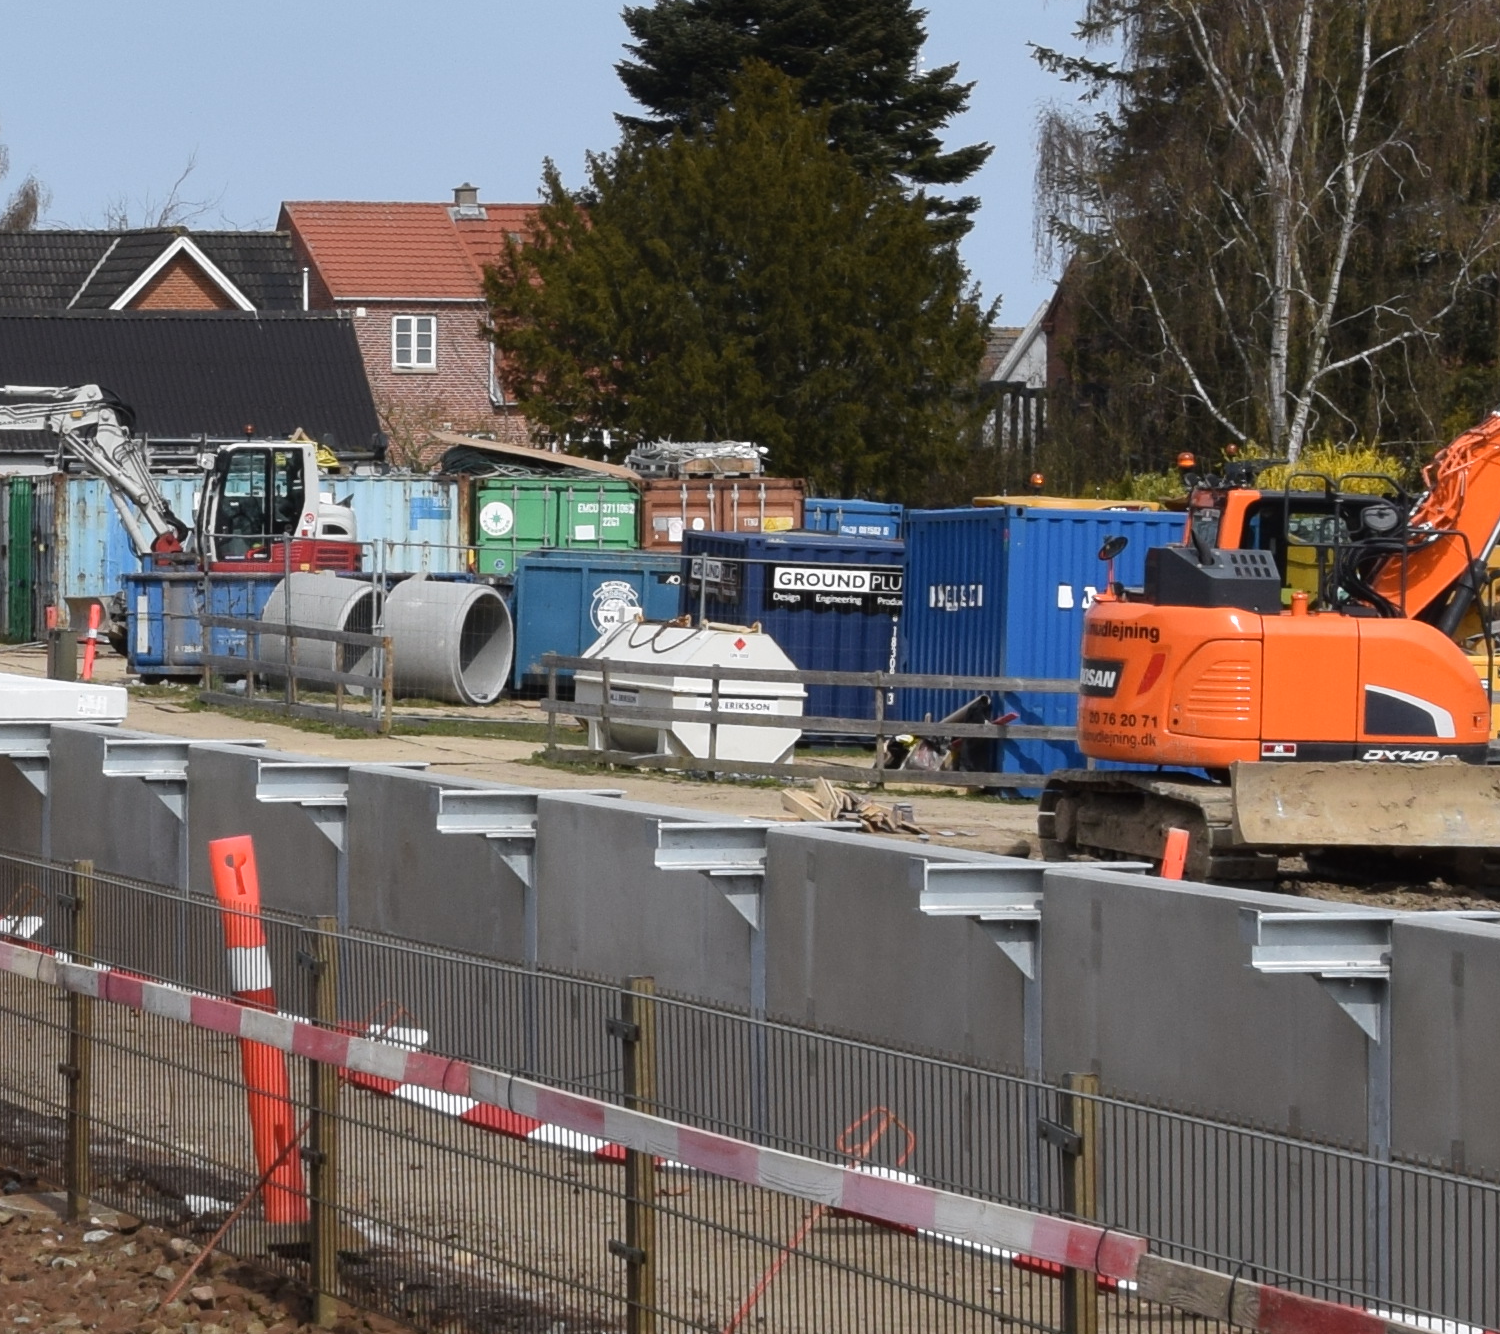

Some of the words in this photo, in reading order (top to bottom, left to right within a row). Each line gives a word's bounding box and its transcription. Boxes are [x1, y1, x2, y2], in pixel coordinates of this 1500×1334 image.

[779, 571, 865, 589] GROUND
[871, 575, 902, 590] PLU
[773, 592, 801, 603] Design
[815, 593, 862, 606] Engineering
[724, 701, 770, 711] ERIKSSON
[1089, 712, 1100, 724] 20
[1102, 712, 1116, 726] 76
[1120, 714, 1137, 727] 20
[1141, 716, 1158, 728] 71
[1363, 749, 1439, 762] DX140
